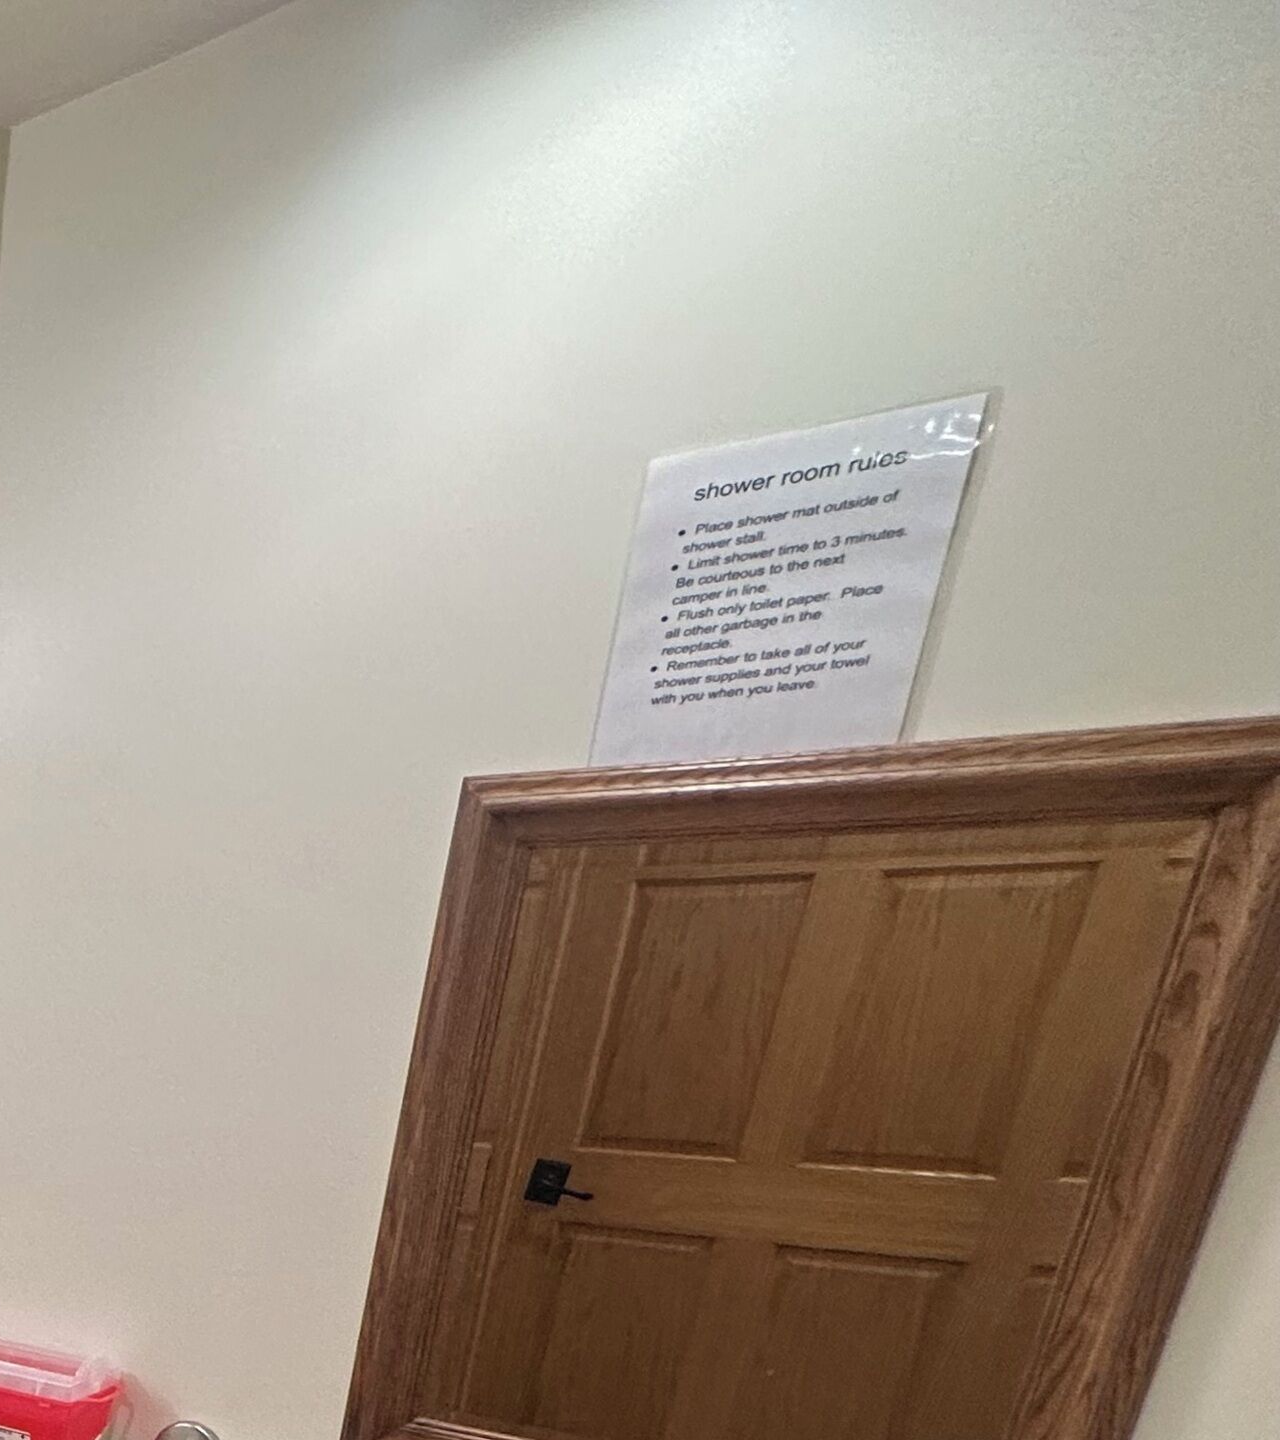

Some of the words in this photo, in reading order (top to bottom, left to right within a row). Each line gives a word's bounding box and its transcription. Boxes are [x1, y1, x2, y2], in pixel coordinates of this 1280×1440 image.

[694, 474, 775, 501] shower
[781, 463, 841, 486] room
[848, 450, 908, 473] rules
[695, 521, 733, 535] Place
[737, 511, 789, 528] shower
[792, 504, 820, 519] mat
[824, 494, 879, 513] outside
[883, 489, 900, 503] of
[682, 538, 731, 554] shower
[688, 554, 721, 570] Limit
[723, 547, 775, 565] shower
[778, 540, 808, 556] time
[813, 536, 827, 550] to
[831, 536, 841, 548] 3
[676, 577, 693, 589] Be
[698, 567, 765, 587] courteous
[769, 564, 783, 576] to
[787, 558, 809, 573] the
[813, 553, 846, 567] next
[672, 589, 722, 607] camper
[726, 585, 738, 597] in
[677, 606, 714, 621] Flush
[718, 603, 747, 618] only
[750, 597, 783, 612] toilet
[840, 583, 884, 599] Place
[665, 626, 681, 640] all
[684, 621, 717, 637] other
[720, 614, 778, 634] garbage
[782, 611, 795, 624] in
[798, 608, 822, 622] the
[654, 674, 702, 689] shower
[705, 668, 760, 685] supplies
[763, 663, 791, 677] and
[794, 661, 827, 676] your
[830, 654, 871, 670] towel
[667, 653, 739, 671] Remember
[744, 651, 756, 663] to
[761, 646, 790, 661] take
[794, 644, 810, 657] all
[814, 641, 831, 655] of
[833, 639, 867, 657] your
[651, 692, 676, 706] with
[679, 691, 704, 705] you
[708, 684, 744, 699] when
[746, 684, 773, 697] you
